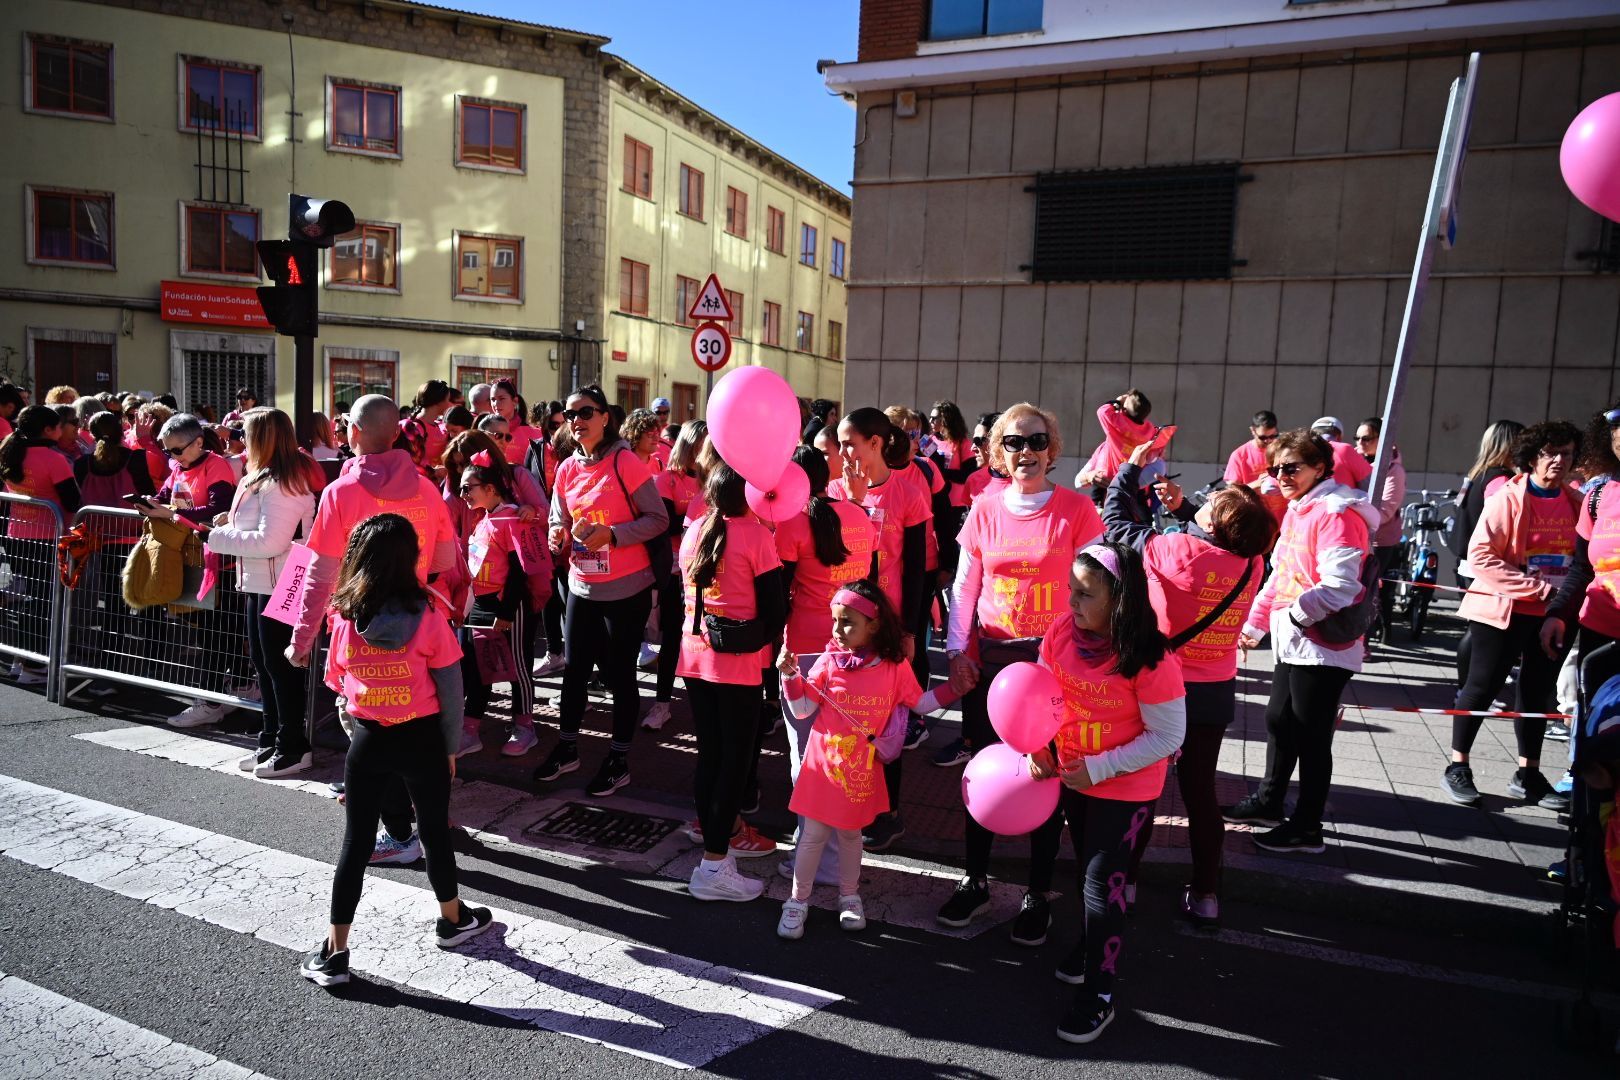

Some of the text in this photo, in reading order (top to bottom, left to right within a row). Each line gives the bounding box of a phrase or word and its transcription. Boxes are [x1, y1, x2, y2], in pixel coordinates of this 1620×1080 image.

[165, 291, 258, 306] Fundación JuanSoñador
[221, 338, 228, 349] 2
[699, 339, 722, 355] 30
[830, 566, 867, 581] ZAPICO
[1202, 630, 1236, 641] abacus
[358, 692, 412, 707] ZAPICO
[835, 690, 894, 707] Drasanví
